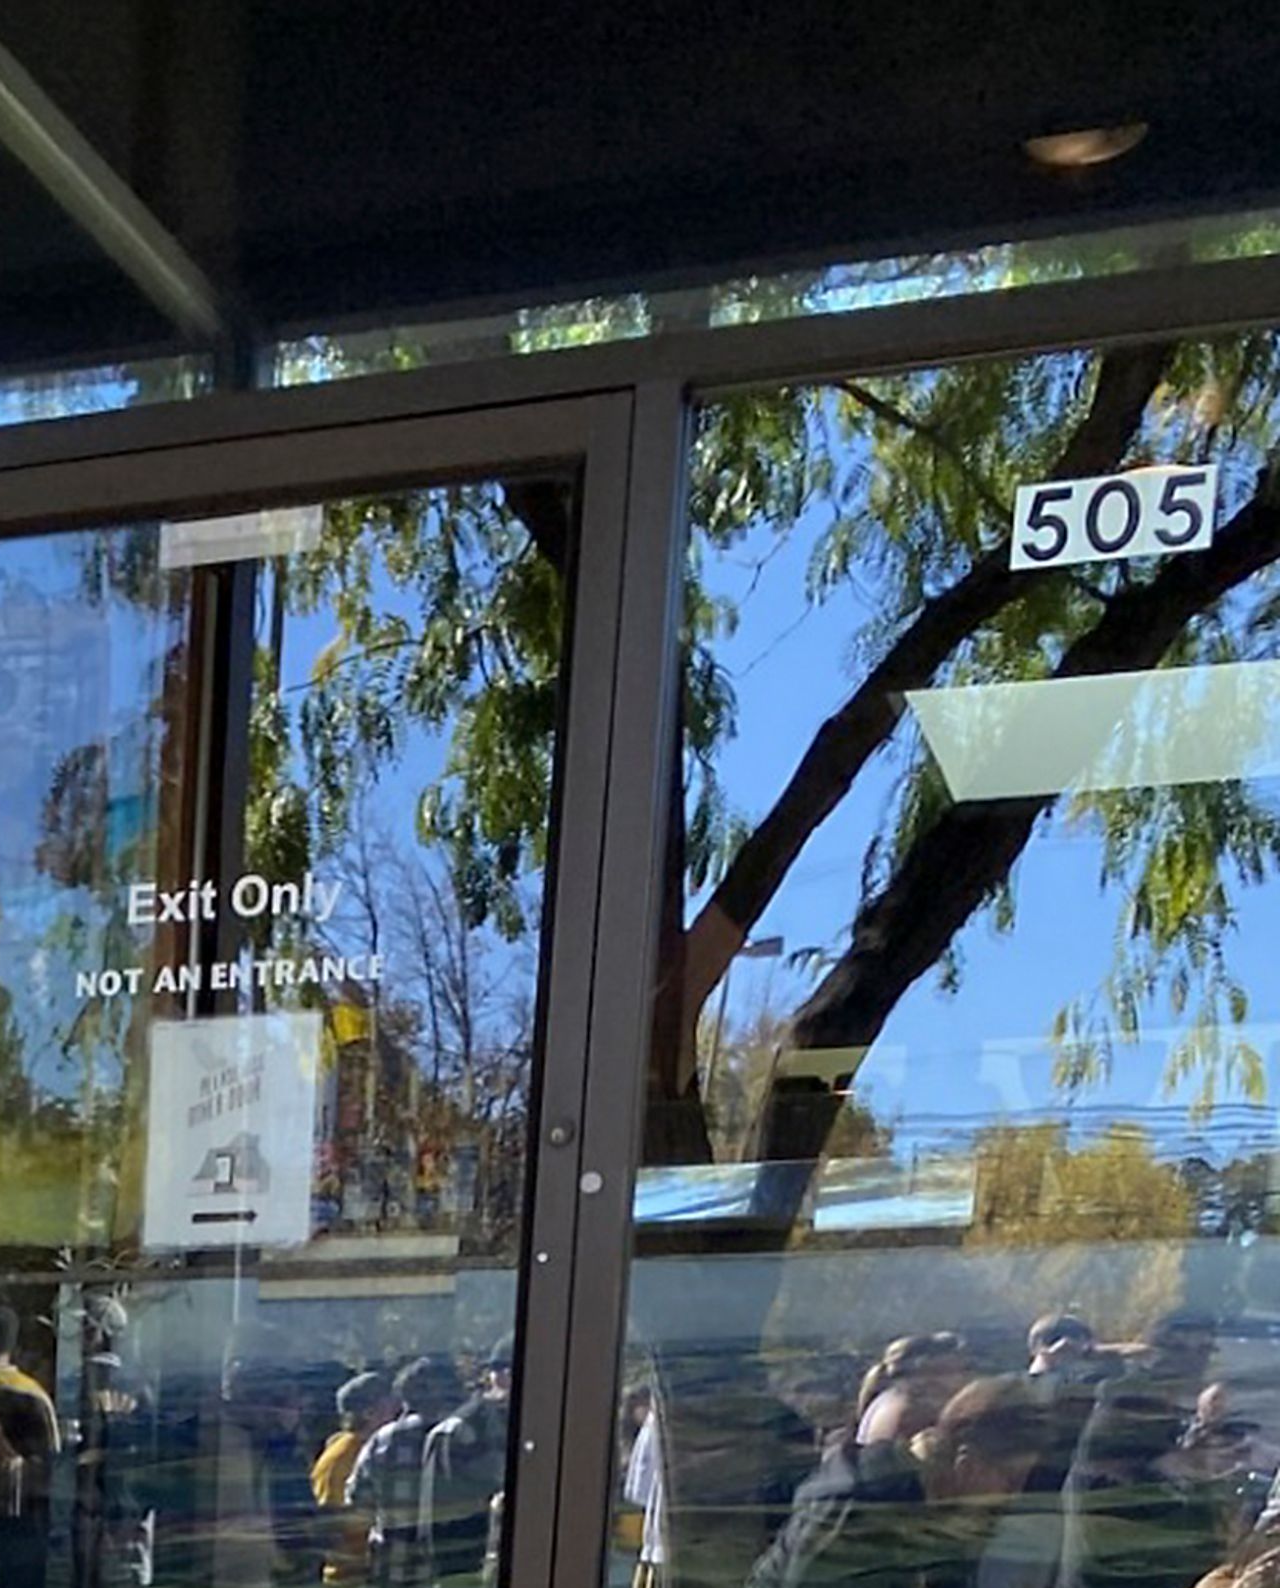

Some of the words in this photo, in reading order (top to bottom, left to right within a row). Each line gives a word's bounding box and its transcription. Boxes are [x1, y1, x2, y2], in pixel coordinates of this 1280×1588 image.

[1021, 472, 1207, 562] 505
[127, 878, 217, 925] Exit
[231, 871, 341, 922] Only
[75, 967, 144, 998] NOT
[152, 963, 202, 993] AN
[210, 952, 387, 990] ENTRANCE
